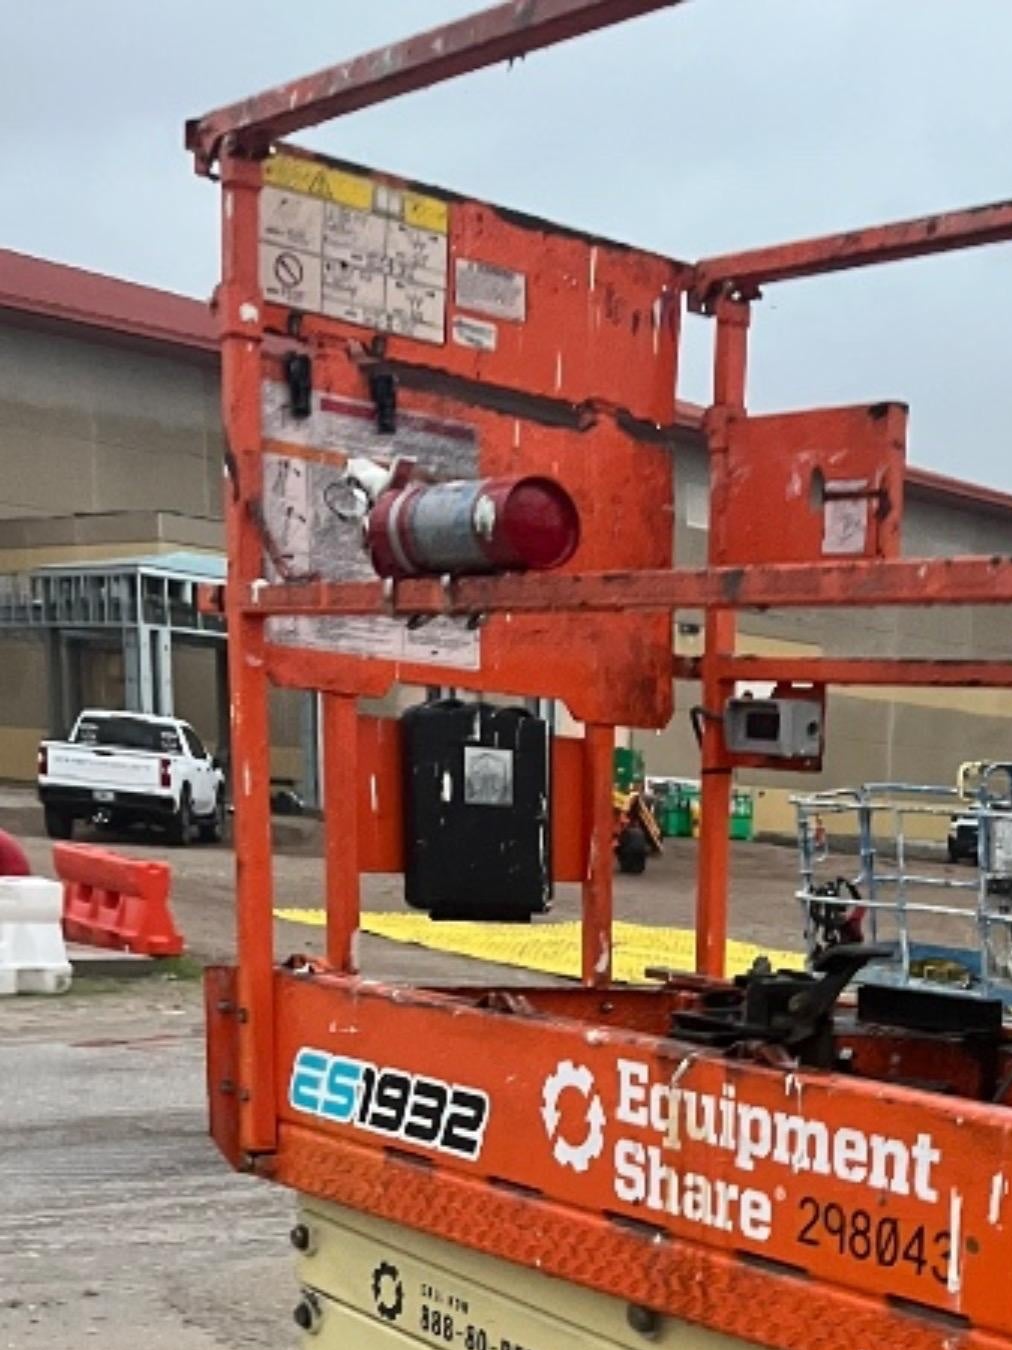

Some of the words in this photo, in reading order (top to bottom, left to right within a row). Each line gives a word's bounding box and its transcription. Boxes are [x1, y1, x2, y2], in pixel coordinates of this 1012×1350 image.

[290, 1047, 491, 1162] ES1932
[615, 1057, 941, 1204] Equipment
[613, 1138, 772, 1241] Share
[797, 1196, 958, 1286] 298043
